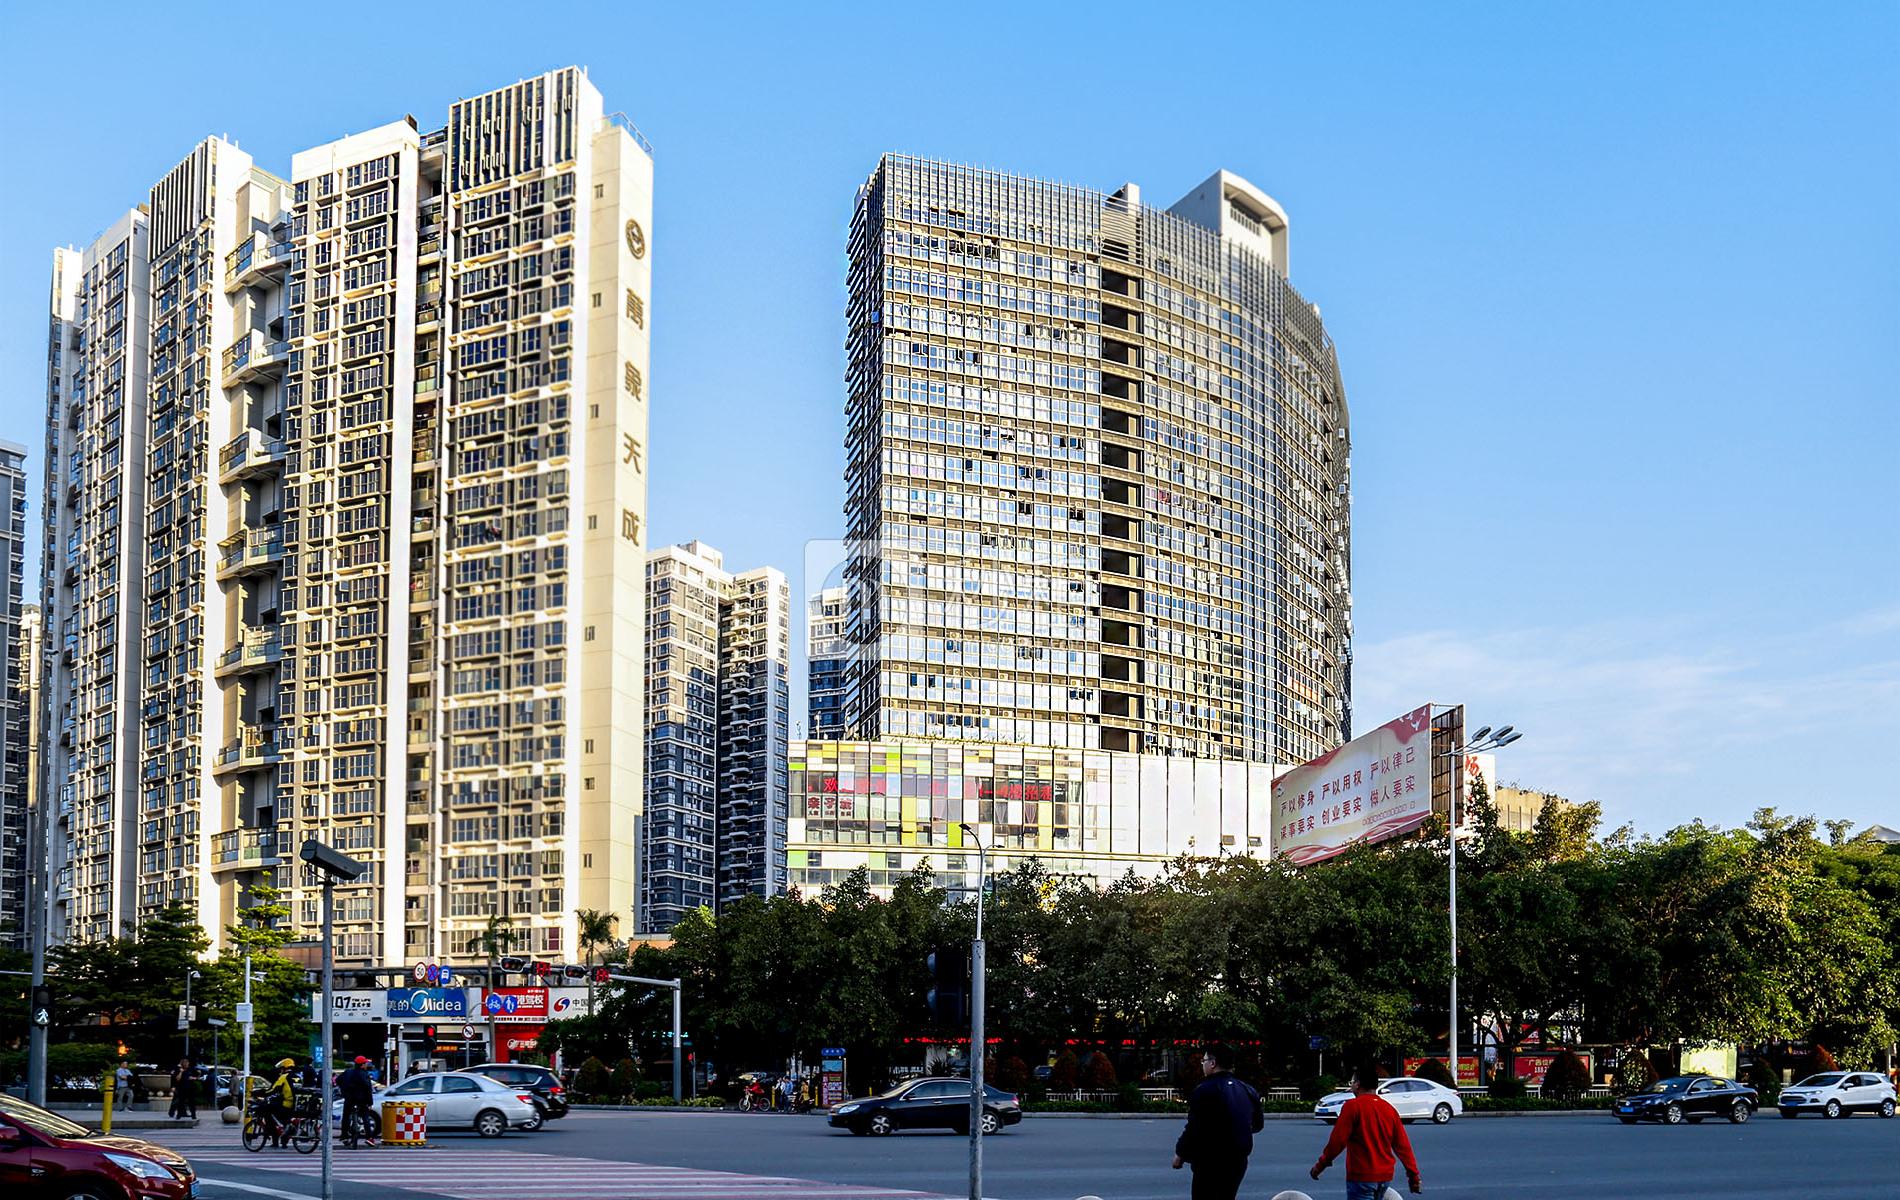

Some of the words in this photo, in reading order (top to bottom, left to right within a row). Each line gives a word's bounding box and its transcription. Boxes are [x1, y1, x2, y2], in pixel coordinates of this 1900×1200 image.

[1280, 790, 1315, 817] 严以修身
[1321, 770, 1362, 800] 严以用权
[1370, 747, 1415, 780] 严以律己
[1321, 796, 1362, 825] 创业要实
[1370, 775, 1415, 807] 做人要实
[416, 967, 425, 976] 50
[387, 999, 409, 1011] 美的
[413, 994, 462, 1011] Midea
